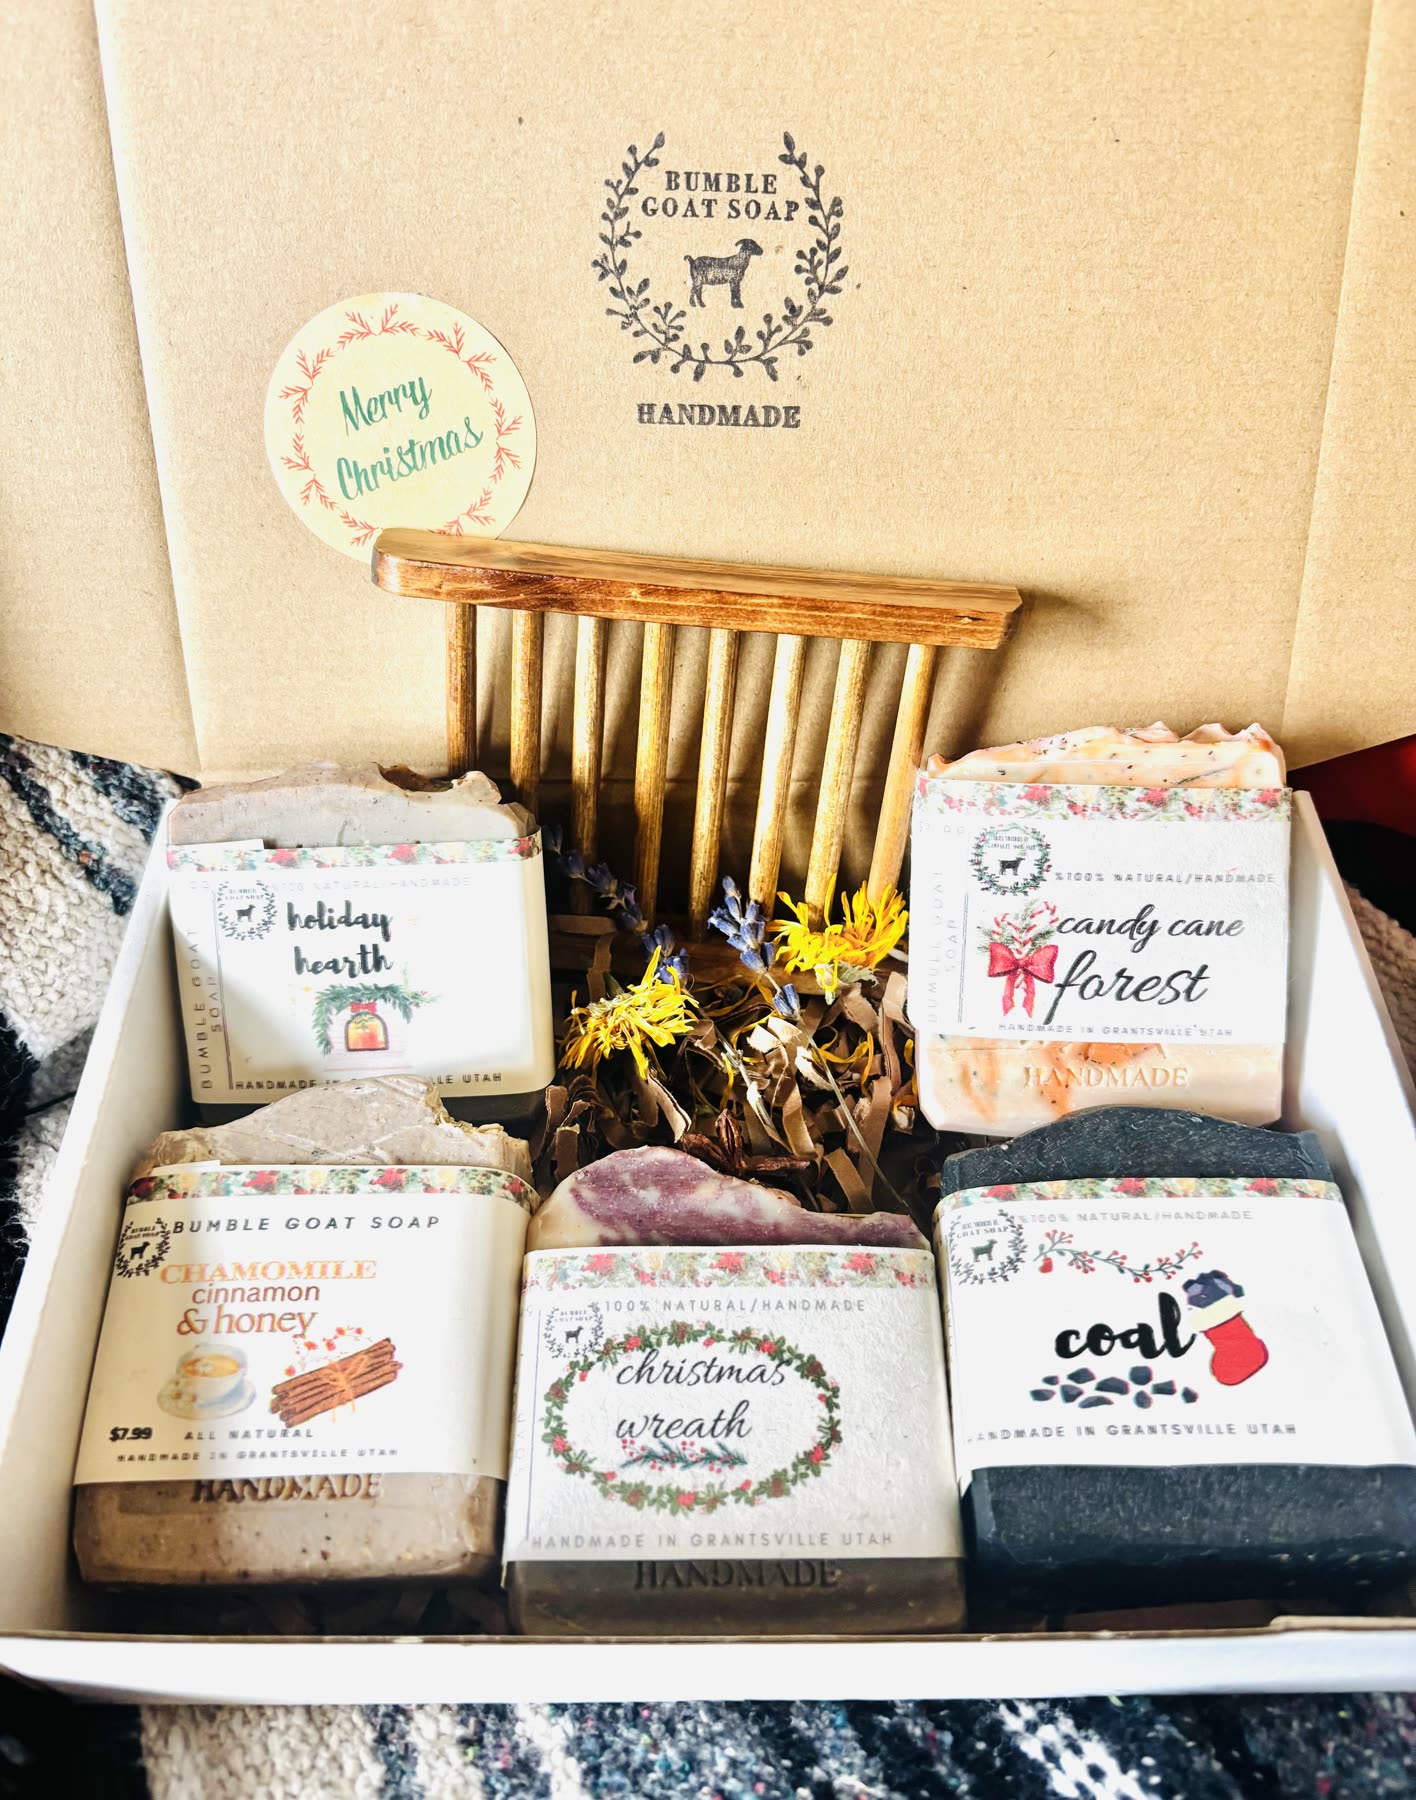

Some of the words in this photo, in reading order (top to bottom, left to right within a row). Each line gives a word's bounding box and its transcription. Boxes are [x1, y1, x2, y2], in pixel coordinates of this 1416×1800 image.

[665, 170, 777, 194] BUMBLE
[641, 196, 718, 218] GOAT
[727, 198, 800, 221] SOAP
[339, 376, 432, 436] Merry
[636, 402, 801, 428] HANDMADE
[336, 416, 483, 501] Christmas
[286, 900, 393, 942] holiday
[1055, 904, 1160, 953] candy
[1168, 915, 1245, 938] cane
[293, 943, 394, 978] hearth
[1042, 949, 1211, 1026] forest
[194, 1001, 213, 1089] BUMBLE
[462, 1073, 502, 1084] UTAH
[1023, 1064, 1189, 1089] HANDMADE
[172, 1217, 271, 1235] BUMBLE
[284, 1216, 355, 1231] GOAT
[370, 1215, 441, 1230] SOAP
[159, 1260, 378, 1285] CHAMOMILE
[191, 1283, 320, 1305] cinnamon
[605, 1300, 651, 1313] 100%
[663, 1299, 866, 1313] NATURAL/HANDMADE
[1054, 1291, 1198, 1360] coal
[615, 1349, 789, 1387] christmas
[615, 1399, 752, 1440] wreath
[109, 1426, 153, 1442] $7.99
[183, 1430, 217, 1441] ALL
[228, 1428, 314, 1440] NATURAL
[967, 1426, 1066, 1443] ANDMADE
[1076, 1425, 1096, 1436] IN
[1105, 1422, 1237, 1436] GRANTSVILLE
[1247, 1423, 1297, 1435] UTAH
[117, 1452, 201, 1462] HANDMADE
[191, 1473, 384, 1503] HANDMADE
[531, 1534, 645, 1551] HANDMADE
[658, 1533, 678, 1547] IN
[690, 1532, 831, 1547] GRANTSVILLE
[842, 1532, 894, 1546] UTAH
[634, 1558, 838, 1590] HANDMADE
